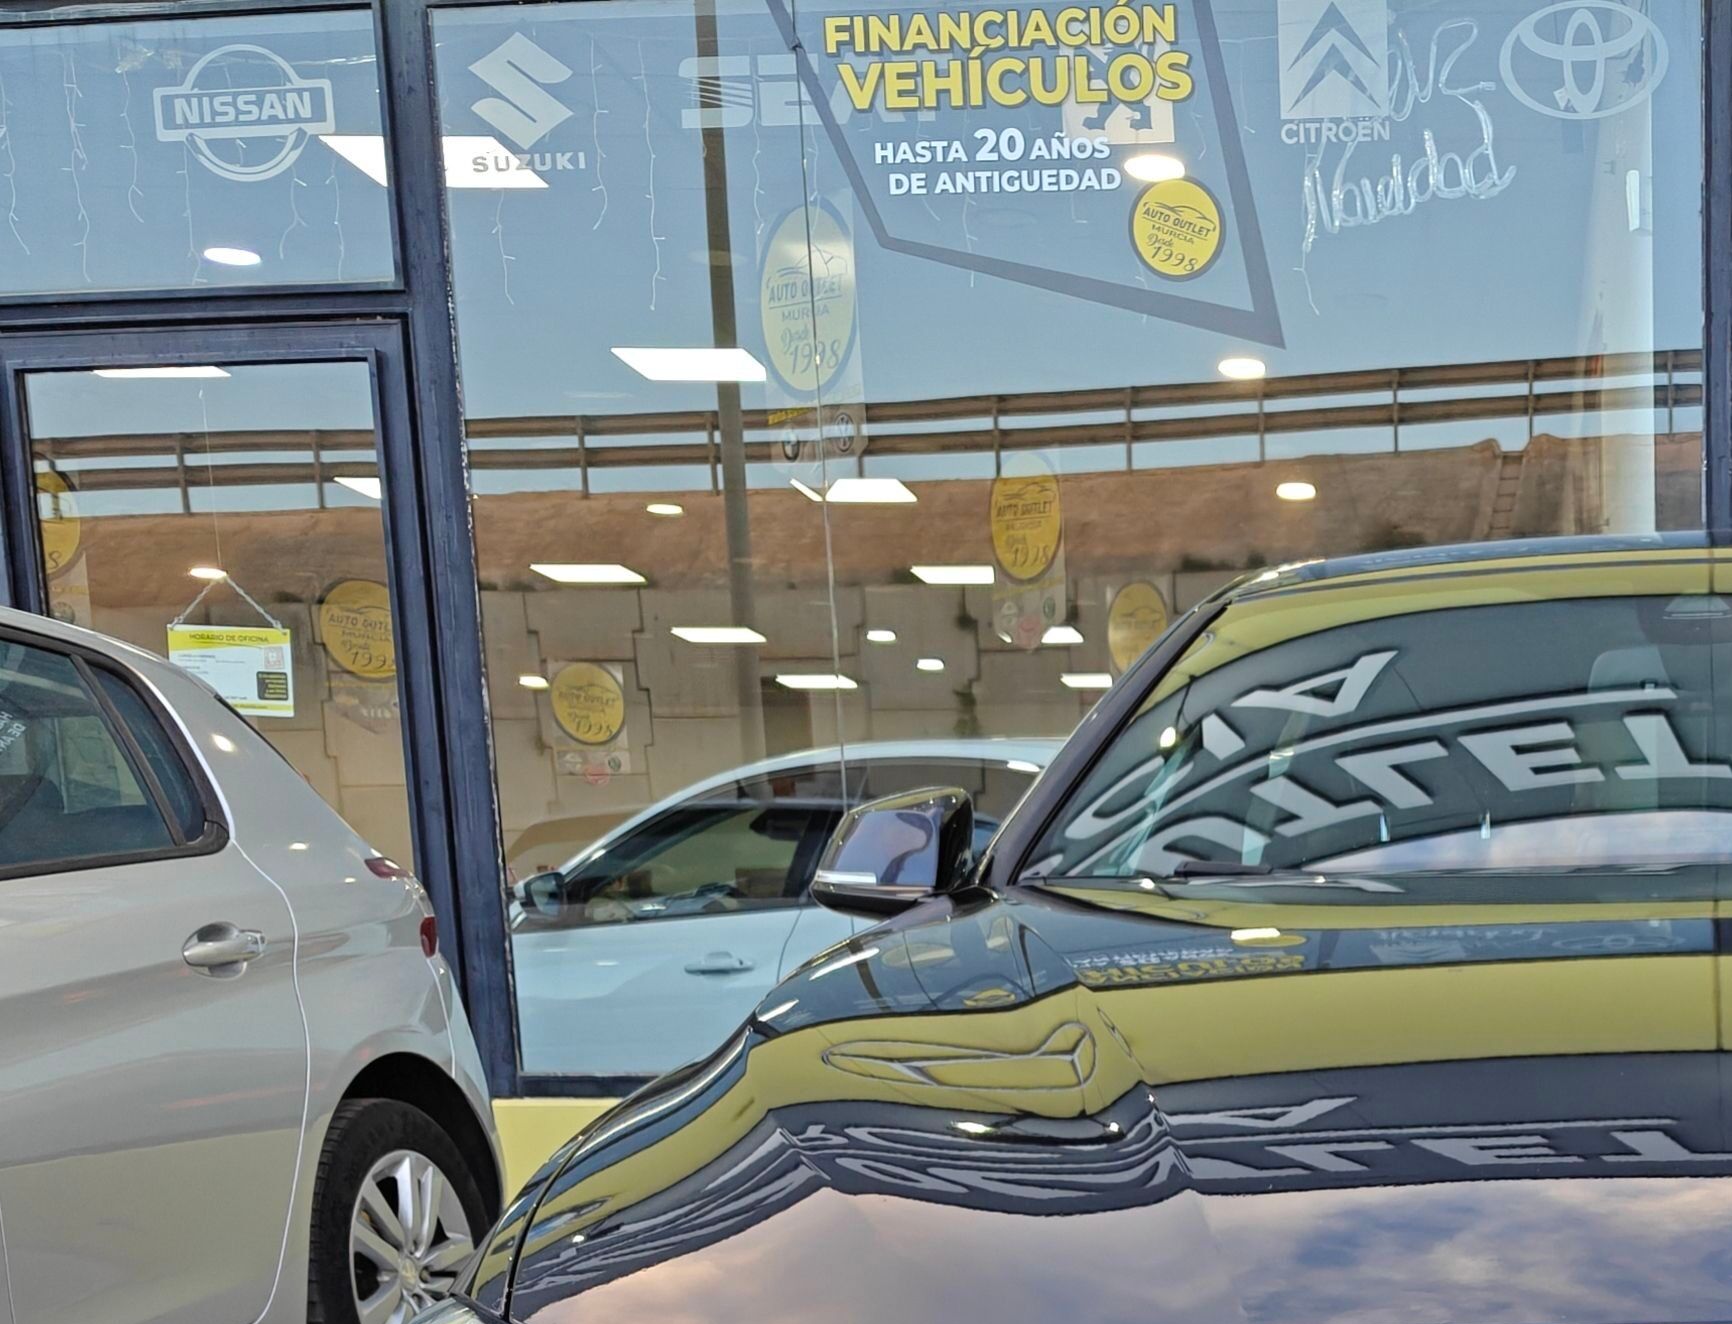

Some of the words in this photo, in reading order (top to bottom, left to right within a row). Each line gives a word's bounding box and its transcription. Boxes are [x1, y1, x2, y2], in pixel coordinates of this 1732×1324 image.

[824, 0, 1176, 54] FINANCIACIÓN
[837, 46, 1193, 110] VEHÍCULOS
[174, 91, 312, 124] NISSAN
[1281, 117, 1390, 144] CITROËN
[874, 141, 969, 165] HASTA
[973, 128, 1025, 162] 20
[1030, 132, 1111, 160] AÑOS
[472, 151, 586, 172] SUZUKI
[889, 173, 928, 195] DE
[934, 168, 1122, 193] ANTIGUEDAD
[1142, 206, 1171, 224] AUTO
[1172, 217, 1211, 238] OUTLET
[1151, 246, 1199, 272] 1998
[768, 282, 797, 305] AUTO
[781, 302, 831, 323] MURIA
[789, 339, 842, 375] 1998
[328, 613, 359, 627] AUTO
